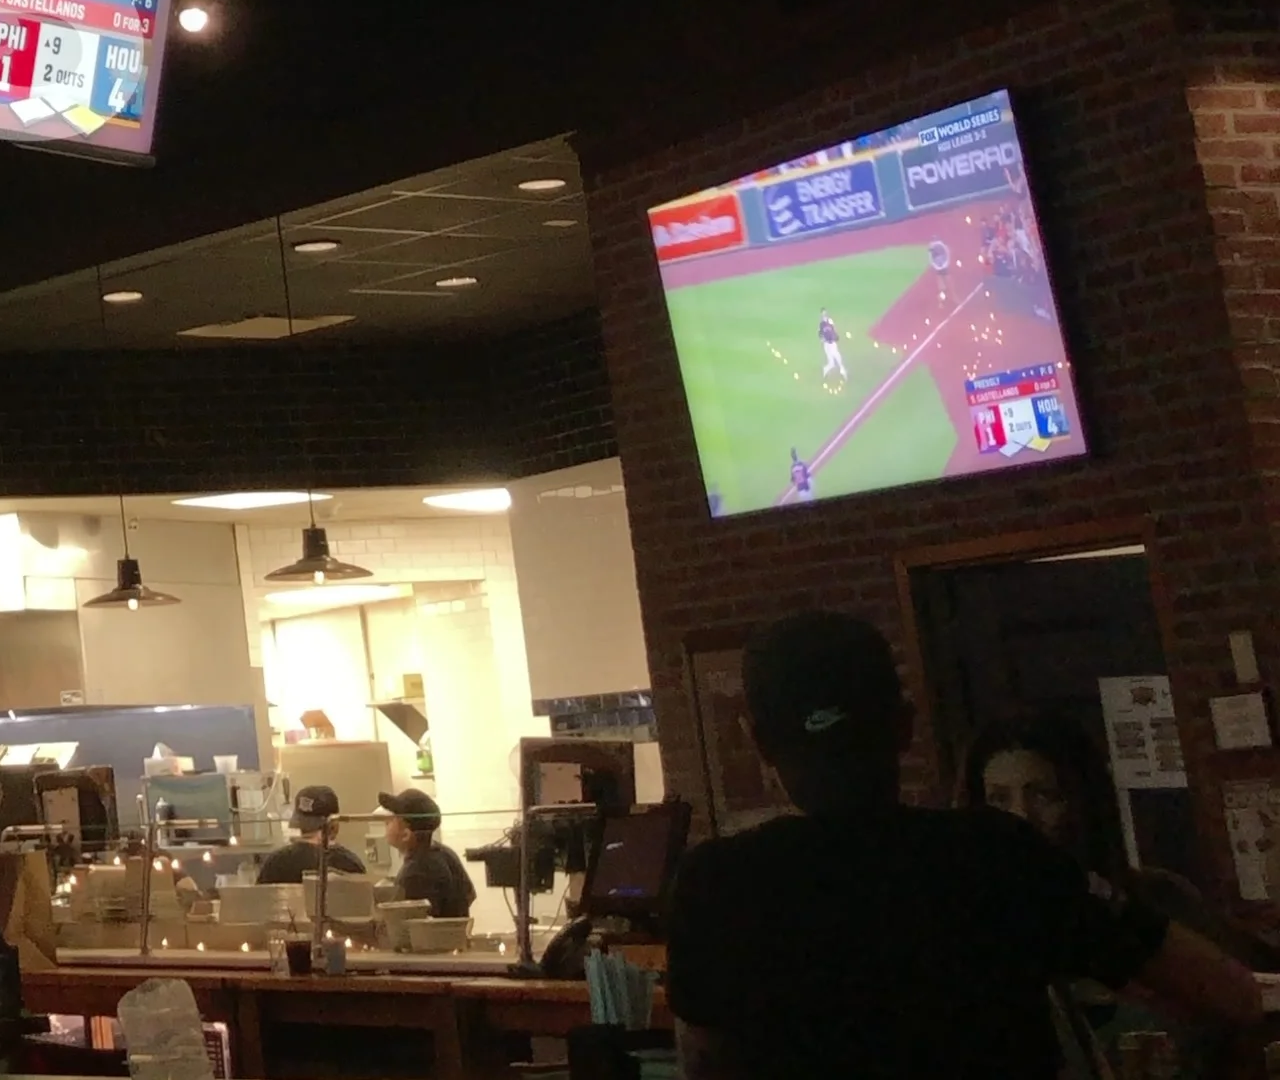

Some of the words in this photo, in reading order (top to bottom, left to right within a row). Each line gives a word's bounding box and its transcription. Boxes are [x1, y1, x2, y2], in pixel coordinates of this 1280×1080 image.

[113, 12, 121, 27] 0
[123, 17, 140, 31] FOR
[141, 18, 149, 33] 3
[52, 37, 62, 55] 9
[105, 45, 141, 73] HOU
[43, 64, 53, 82] 2
[56, 70, 85, 88] OUTS
[108, 78, 125, 112] 4
[920, 127, 938, 145] FOX
[938, 119, 971, 138] WORLD
[971, 109, 1000, 128] SERIES
[796, 170, 853, 203] ENERGY
[799, 191, 876, 226] TRANSFER
[976, 386, 1019, 403] CASTELLANOS
[1037, 398, 1058, 413] HOU
[1047, 415, 1058, 434] 4
